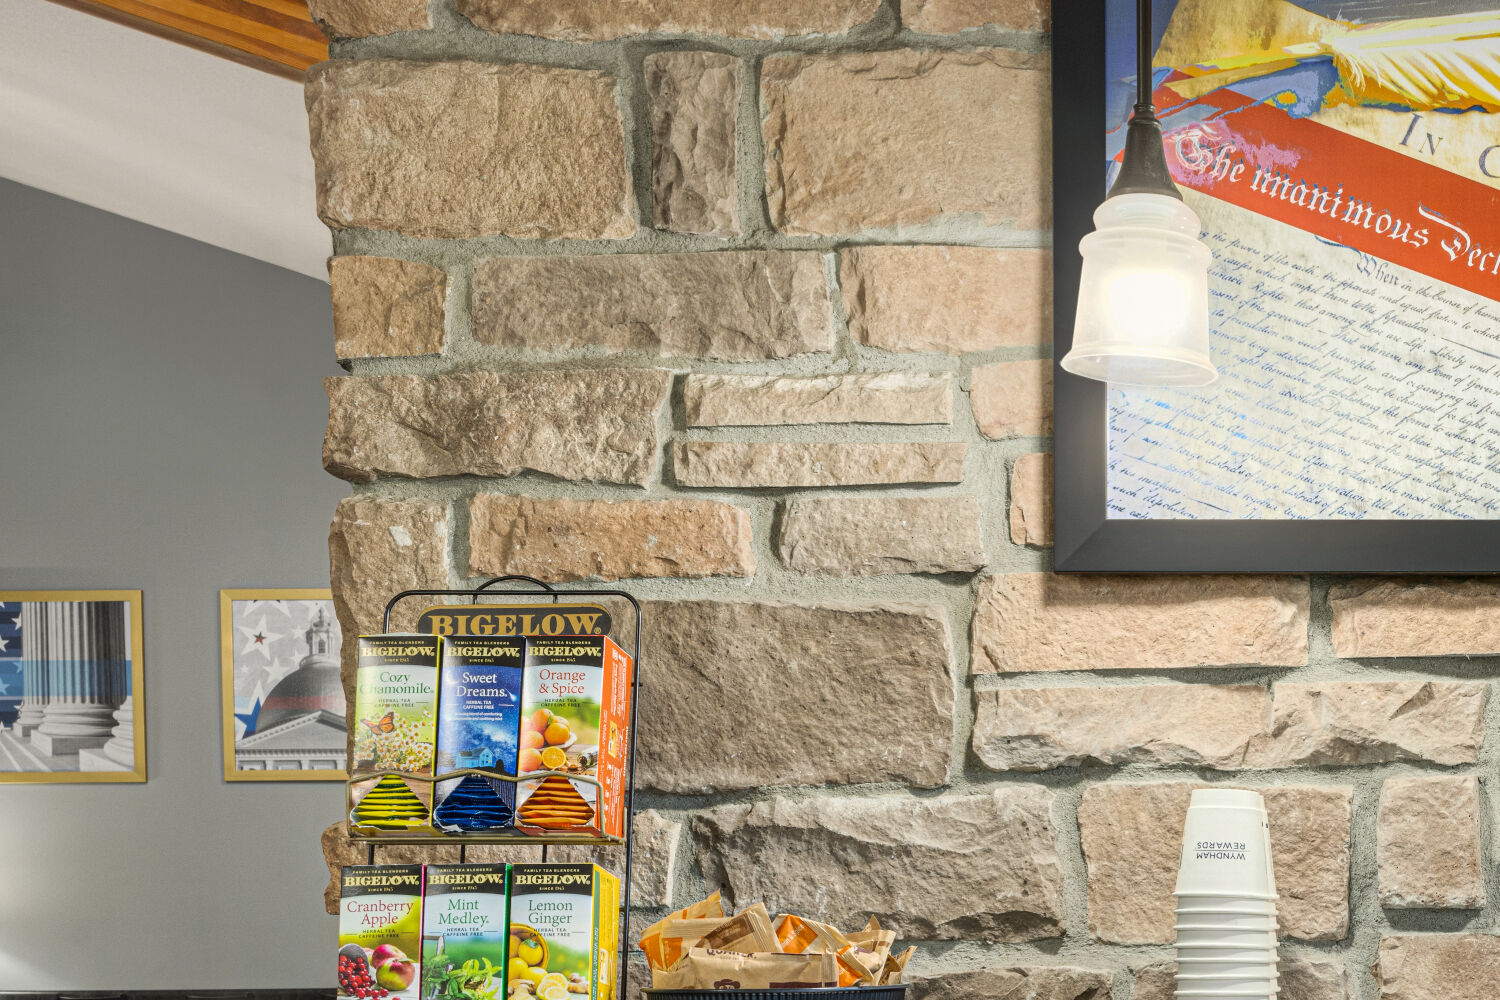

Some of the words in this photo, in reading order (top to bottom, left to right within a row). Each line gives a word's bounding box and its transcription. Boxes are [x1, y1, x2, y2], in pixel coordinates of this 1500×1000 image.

[1172, 122, 1246, 183] The
[1250, 166, 1429, 248] unanimous
[1356, 254, 1398, 284] When
[1400, 279, 1411, 291] in
[1316, 309, 1355, 328] among
[428, 613, 603, 635] BIGELOW
[362, 646, 433, 657] BIGELOW
[446, 647, 519, 657] BIGELOW
[528, 647, 600, 656] BIGELOW
[380, 671, 410, 684] Cozy
[462, 672, 497, 684] Sweet
[539, 669, 586, 686] Orange
[456, 686, 505, 697] Dreams
[539, 683, 548, 694] &
[551, 683, 585, 697] Spice
[1197, 842, 1246, 850] REWARDS
[1196, 852, 1246, 860] WYNDHAM
[344, 875, 417, 886] BIGELOW
[429, 873, 501, 885] BIGELOW
[515, 874, 588, 885] BIGELOW
[347, 899, 414, 915] Cranberry
[448, 899, 479, 911] Mint
[529, 900, 573, 911] Lemon
[361, 913, 398, 928] Apple
[438, 912, 487, 927] Medley
[528, 912, 572, 926] Ginger
